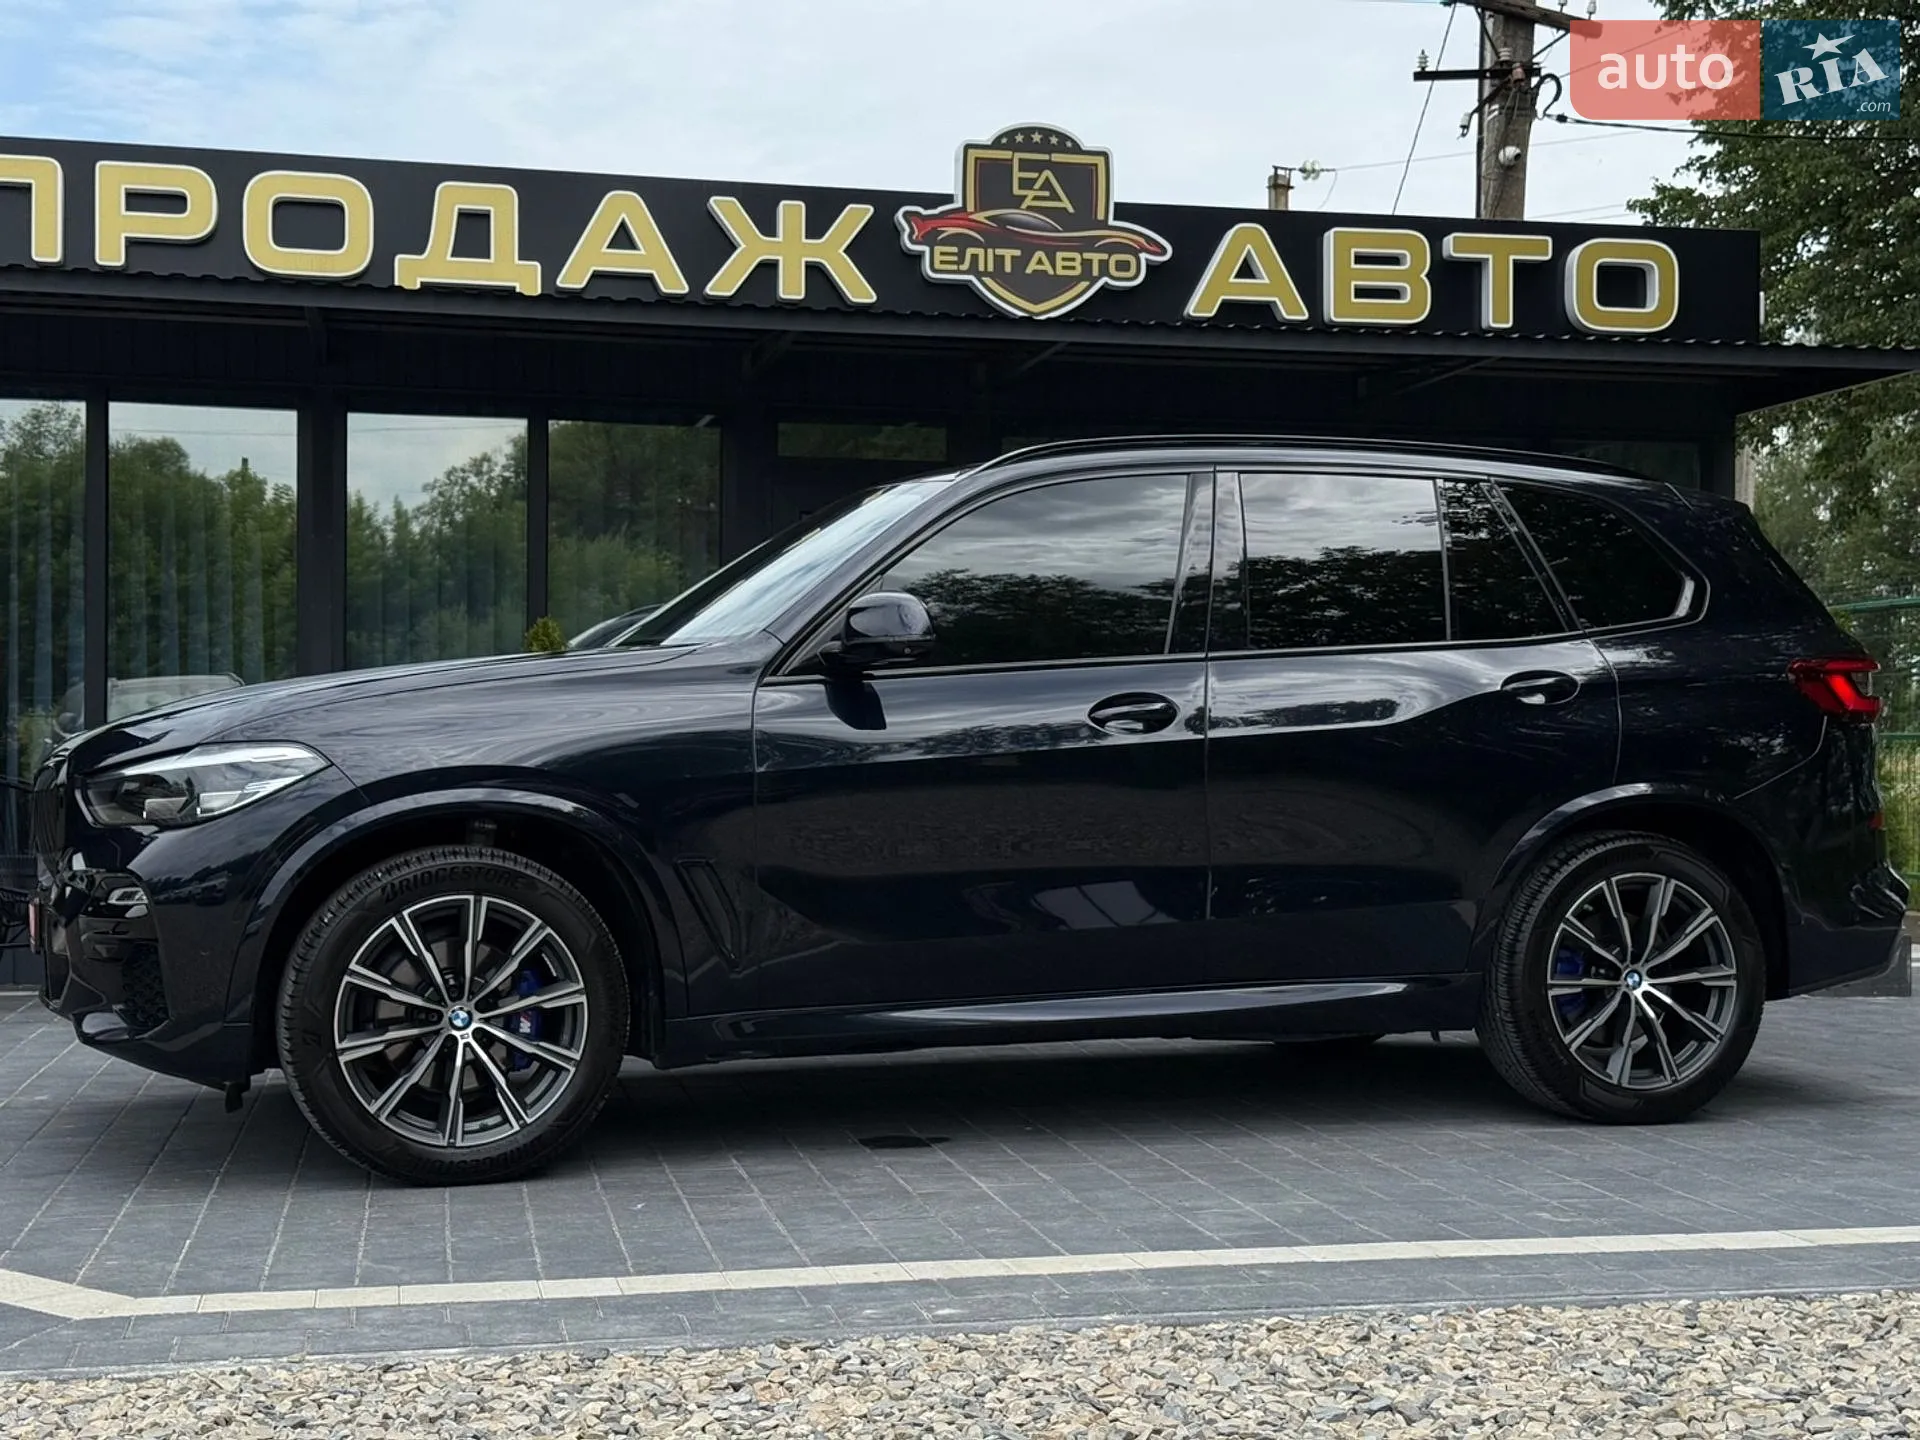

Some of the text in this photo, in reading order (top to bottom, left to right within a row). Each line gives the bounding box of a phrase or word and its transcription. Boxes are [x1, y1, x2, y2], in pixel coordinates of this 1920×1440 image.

[933, 246, 1138, 279] ЕЛІТ АВТО
[1184, 222, 1680, 334] АВТО
